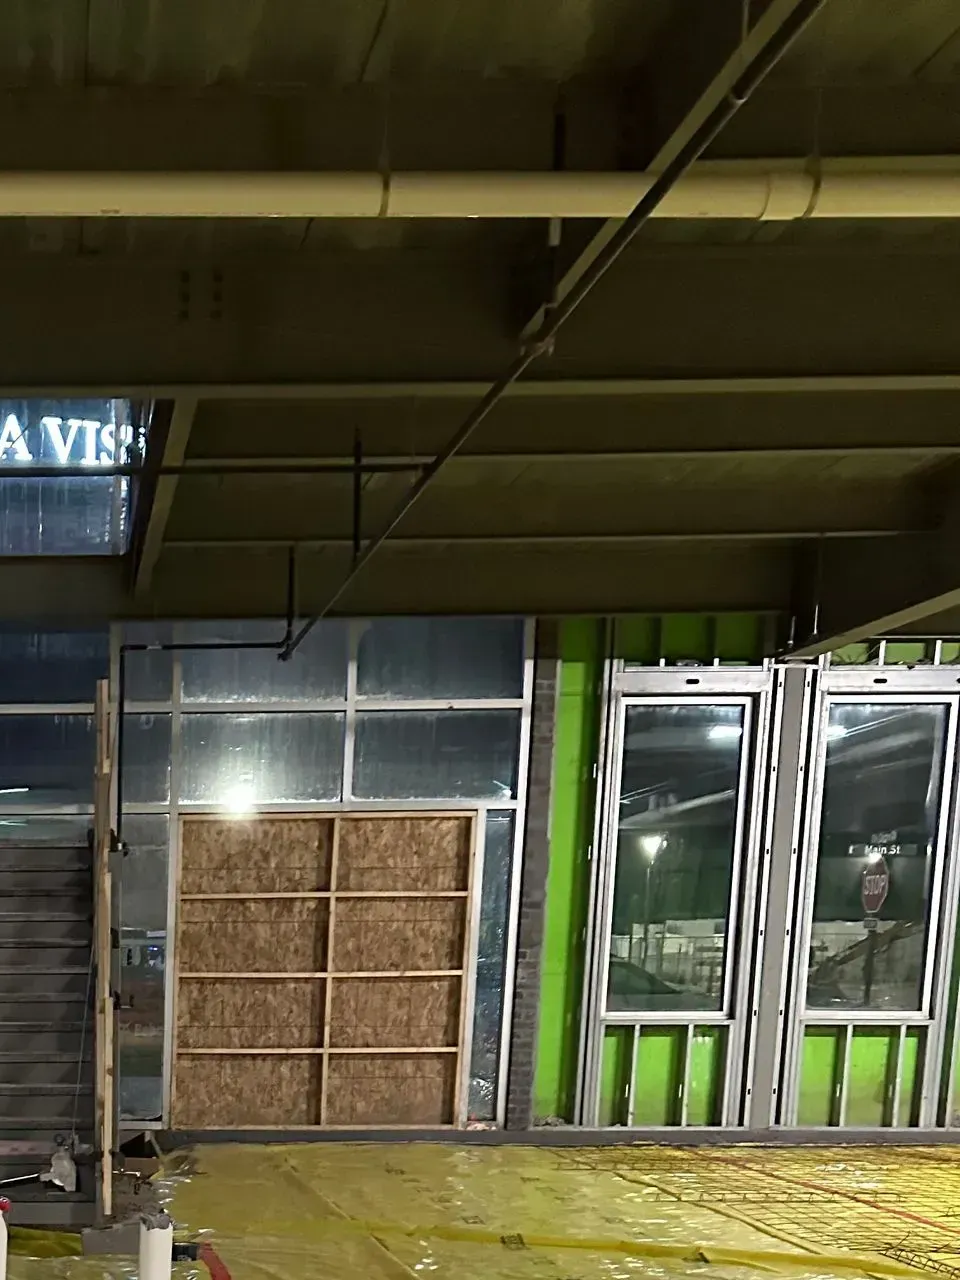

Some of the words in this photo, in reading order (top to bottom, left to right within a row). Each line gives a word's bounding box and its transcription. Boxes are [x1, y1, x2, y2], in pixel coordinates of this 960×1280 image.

[41, 416, 134, 465] VIS
[864, 844, 887, 856] Main
[888, 844, 900, 855] St
[864, 875, 886, 895] STOP
